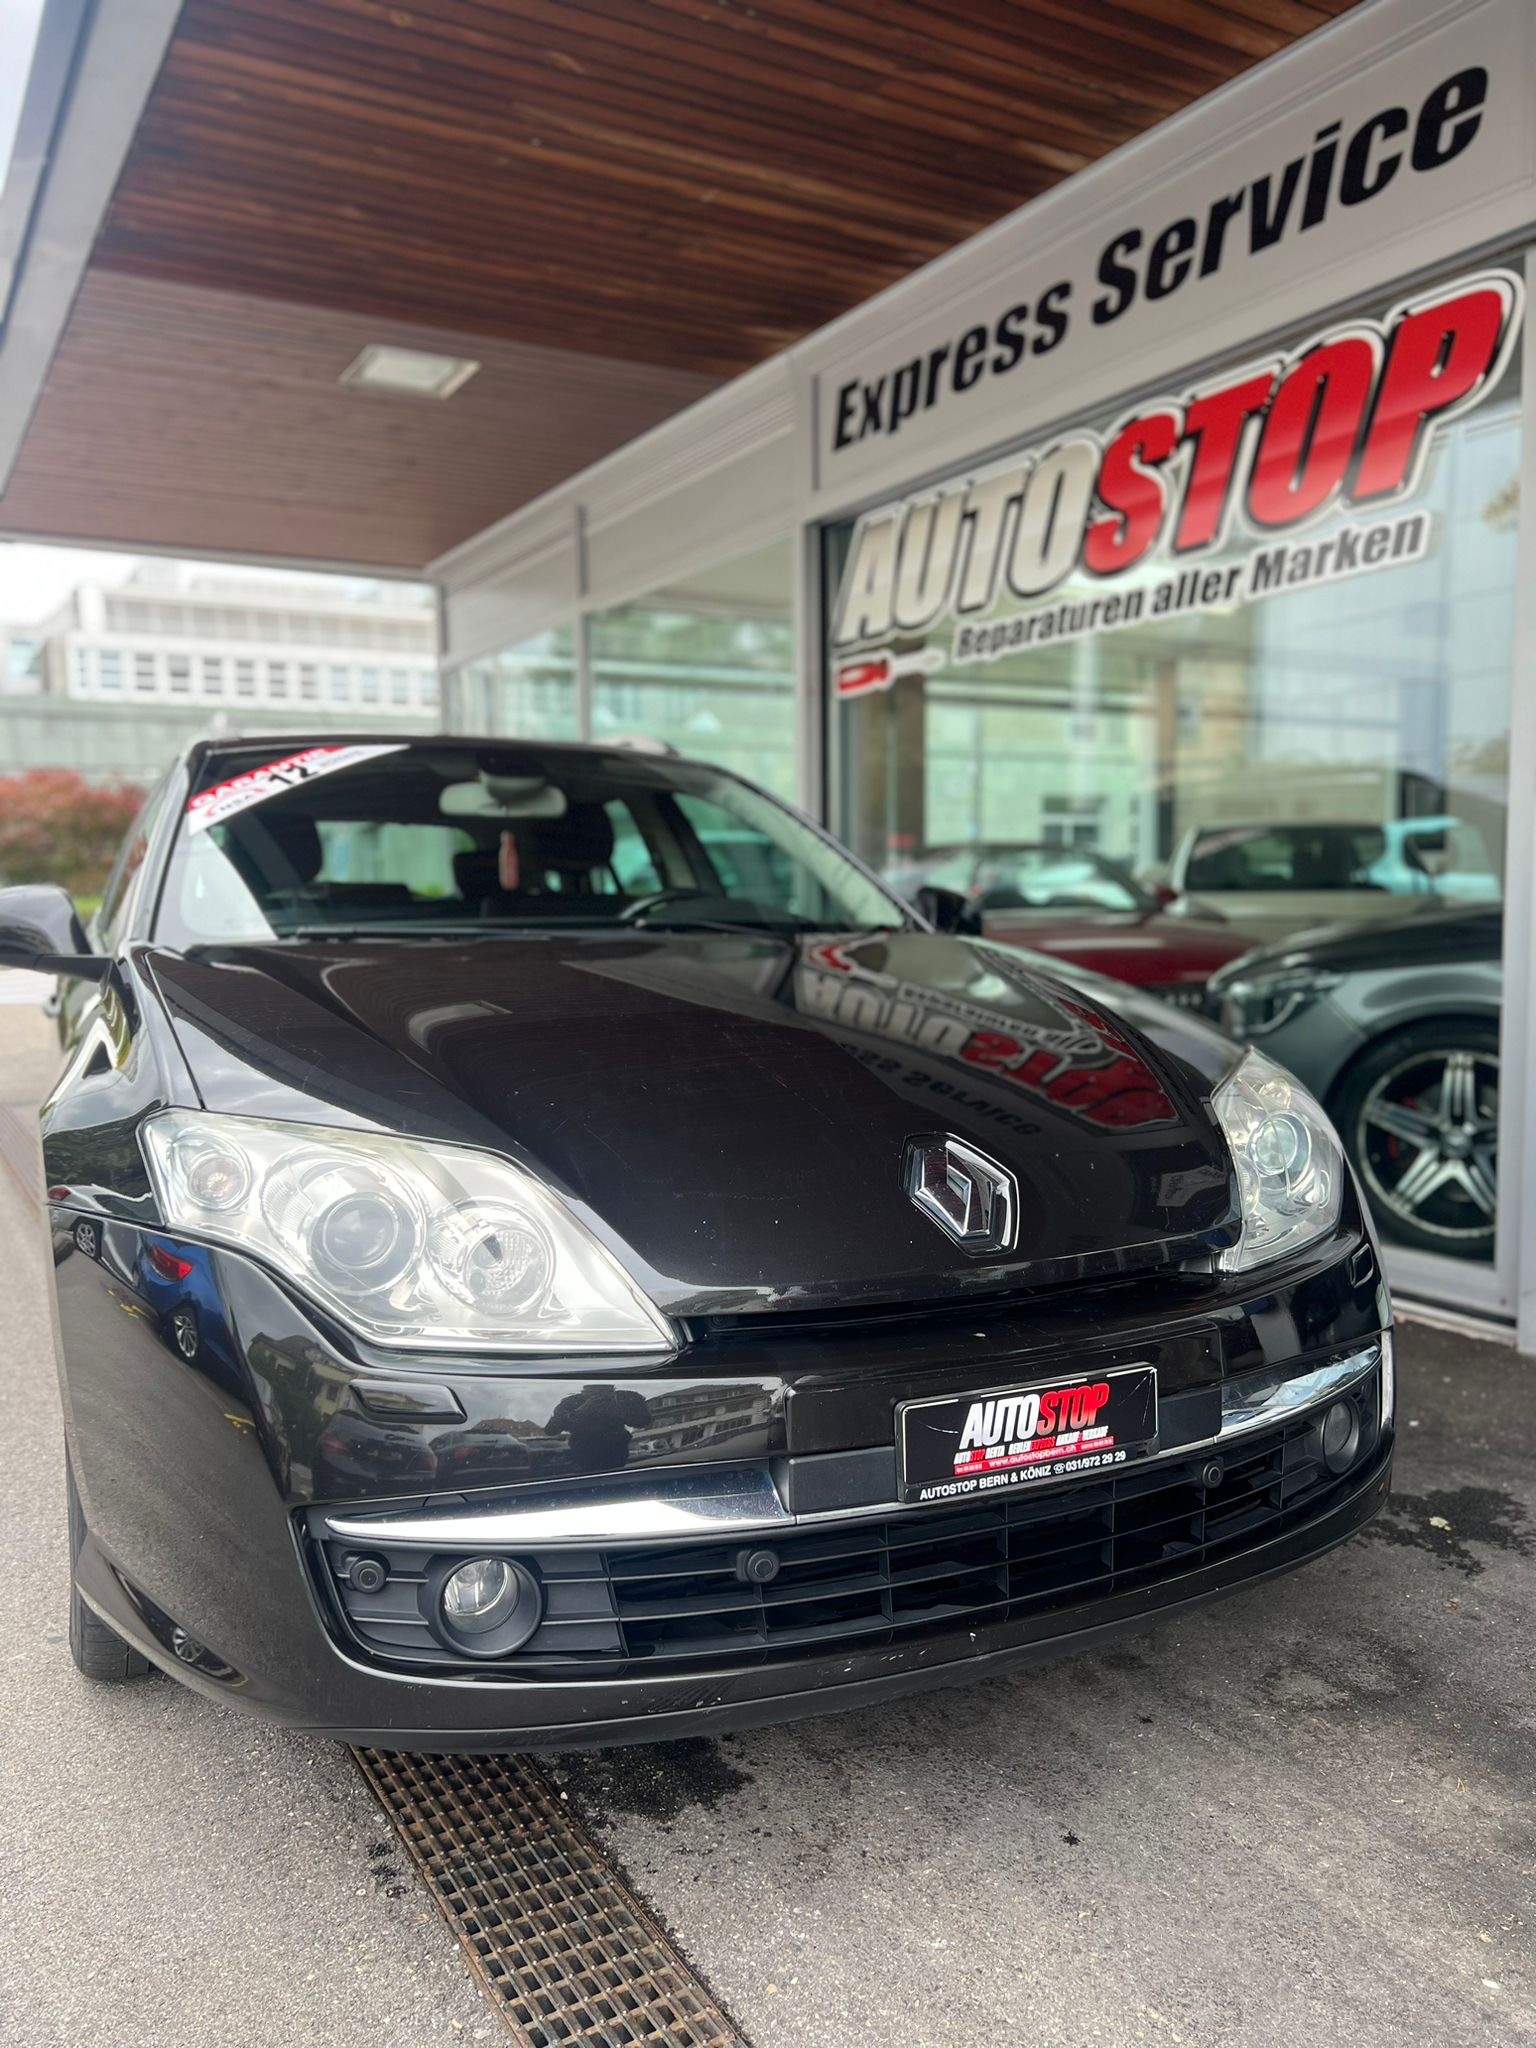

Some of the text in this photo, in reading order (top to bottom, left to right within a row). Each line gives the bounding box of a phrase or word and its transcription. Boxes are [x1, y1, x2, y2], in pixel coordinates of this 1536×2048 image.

[833, 66, 1489, 452] Express Service
[832, 285, 1508, 645] AUTOSTOP
[956, 513, 1426, 659] Reparaturen aller Marken
[959, 1383, 1110, 1449] AUTOSTOP
[989, 1445, 1076, 1467] www.autostopbern.ch
[920, 1450, 1126, 1500] AUTOSTOP BERN & KÖNIZ 031/972 29 29
